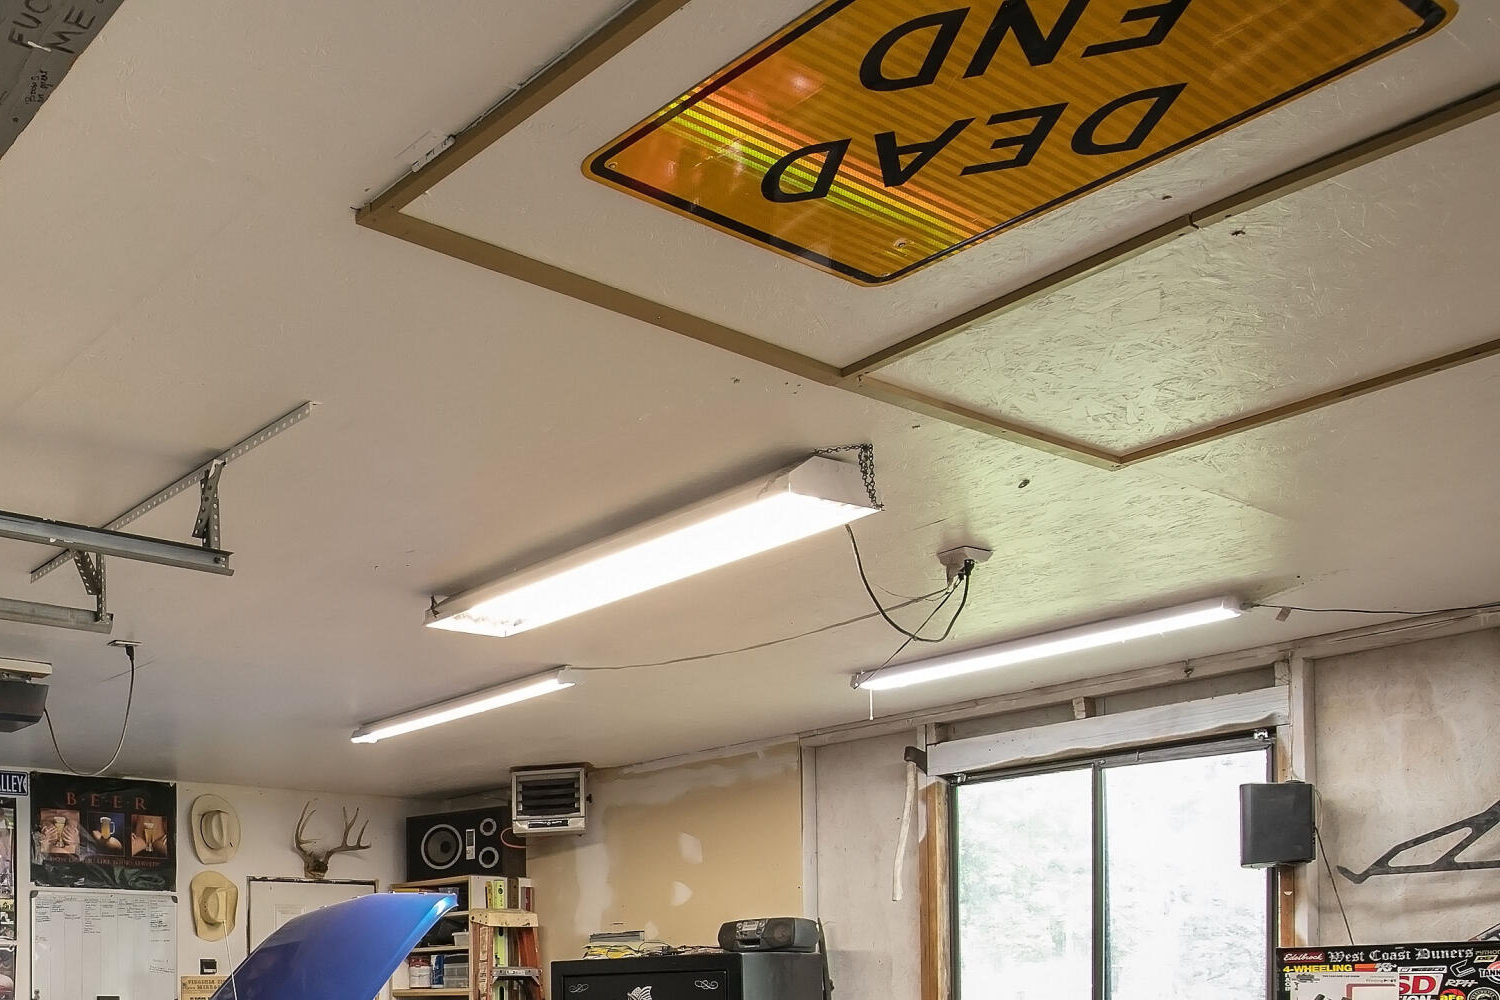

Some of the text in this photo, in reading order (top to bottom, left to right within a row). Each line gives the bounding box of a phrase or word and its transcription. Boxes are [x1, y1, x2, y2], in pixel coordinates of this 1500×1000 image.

[7, 0, 51, 50] FUC
[47, 5, 96, 54] ME
[859, 0, 1195, 92] END
[760, 83, 1189, 203] DEAD
[1282, 964, 1353, 973] 4-WHEELING
[1283, 952, 1324, 961] Edelbrock
[1327, 947, 1474, 962] West Coast Duners
[1398, 975, 1438, 995] SD
